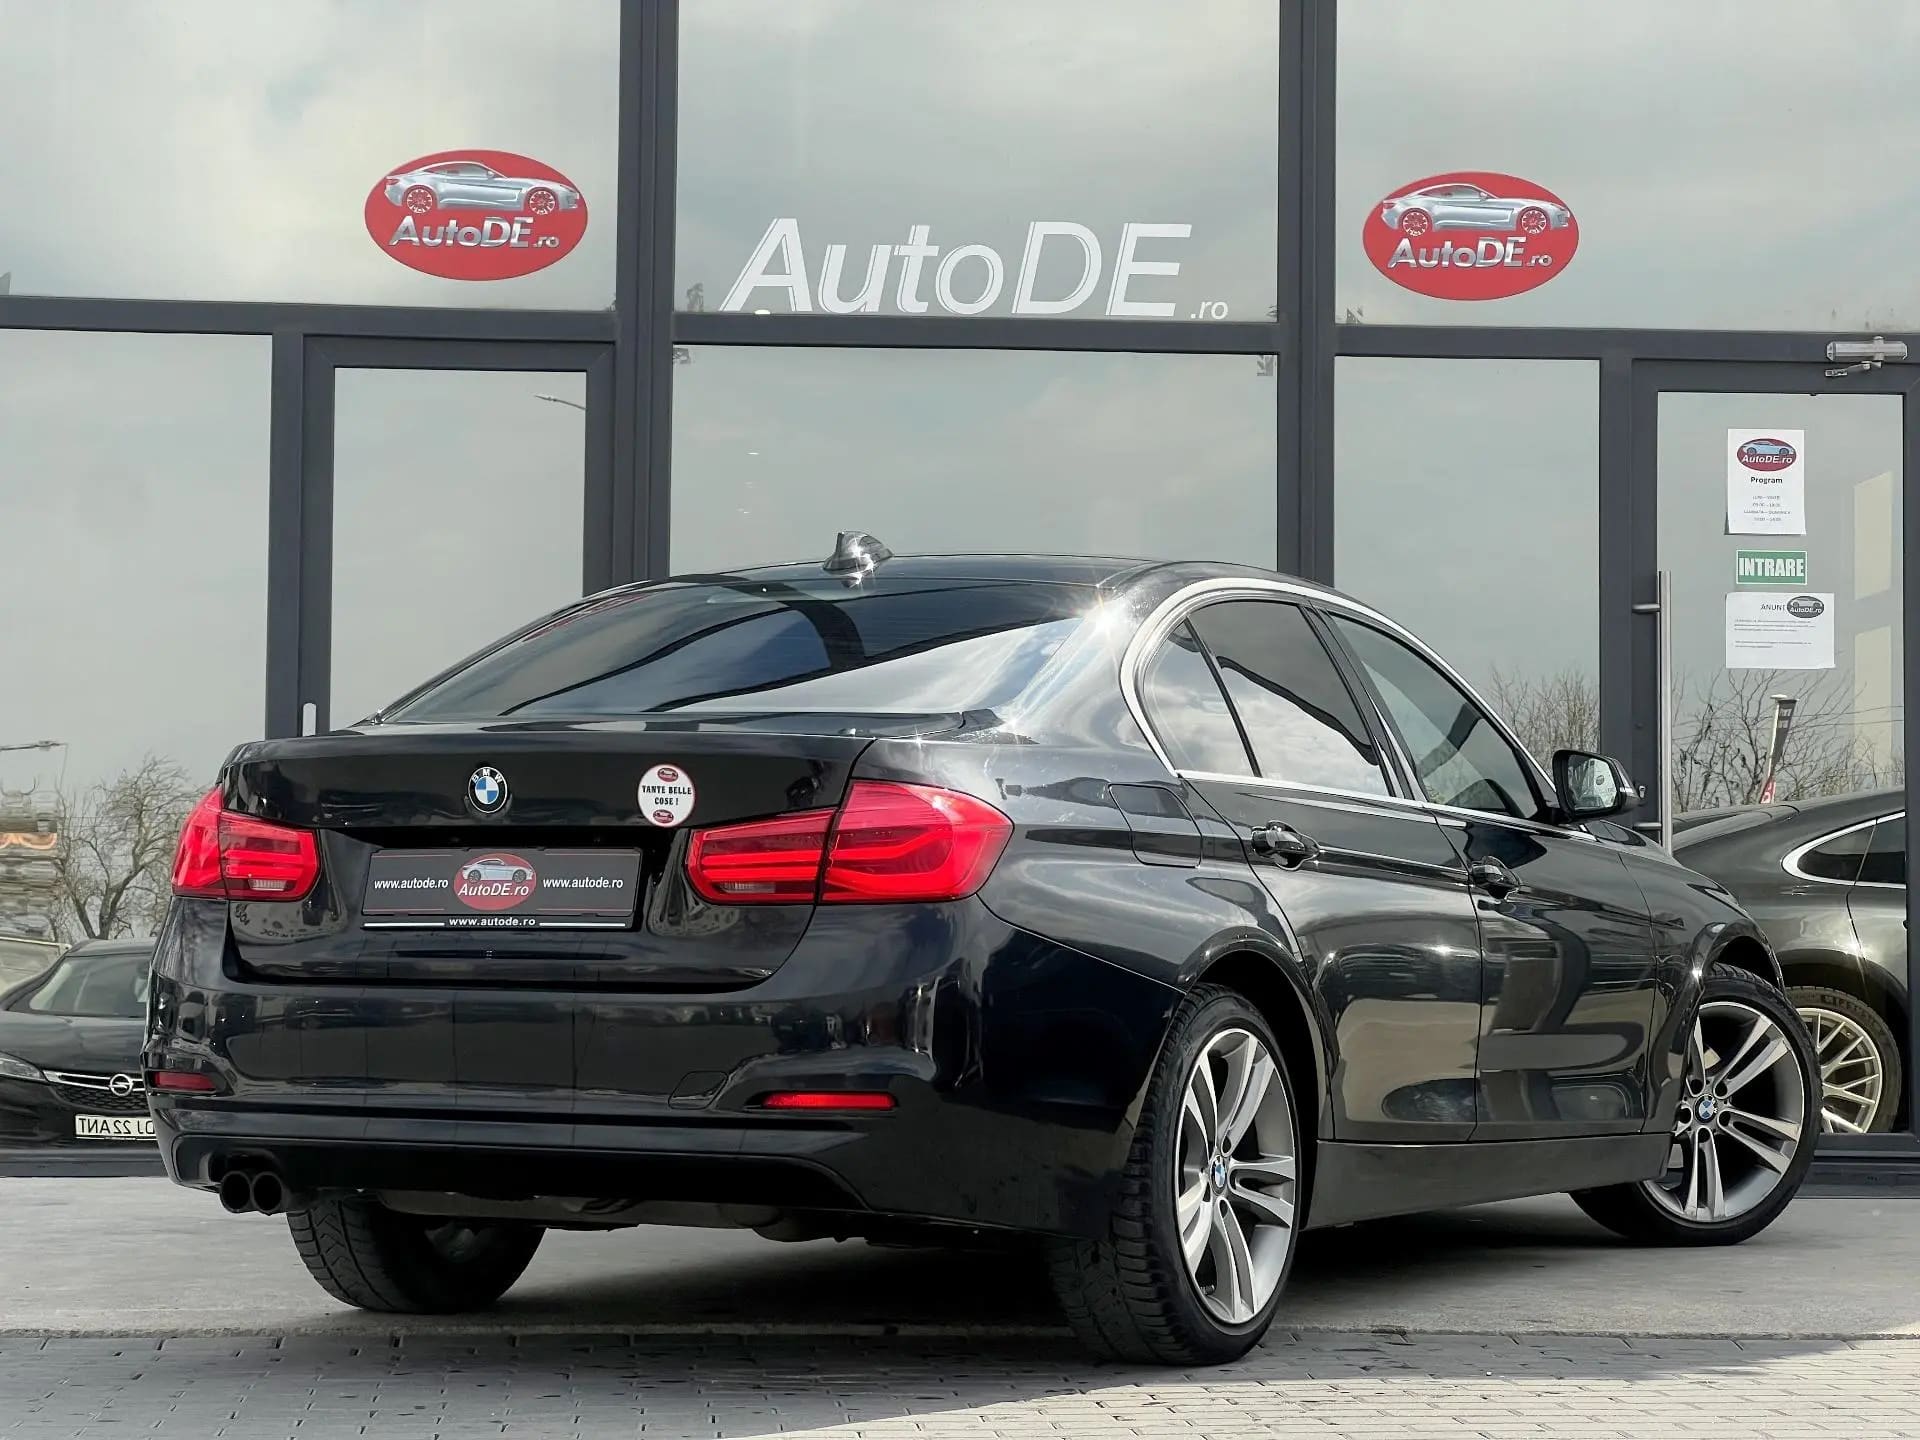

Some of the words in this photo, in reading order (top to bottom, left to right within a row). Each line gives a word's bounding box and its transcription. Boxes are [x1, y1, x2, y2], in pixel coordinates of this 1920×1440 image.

[1741, 454, 1793, 464] AutoDE.ro
[1750, 476, 1783, 485] Program
[1738, 557, 1805, 578] INTRARE
[471, 768, 503, 784] BMW
[641, 785, 666, 794] TANTE
[668, 786, 692, 795] BELLE
[654, 797, 674, 806] COSE
[374, 877, 449, 890] www.autode.ro
[542, 876, 624, 890] www.autode.ro
[458, 882, 530, 897] AutoDE.ro
[449, 916, 536, 927] www.autode.ro
